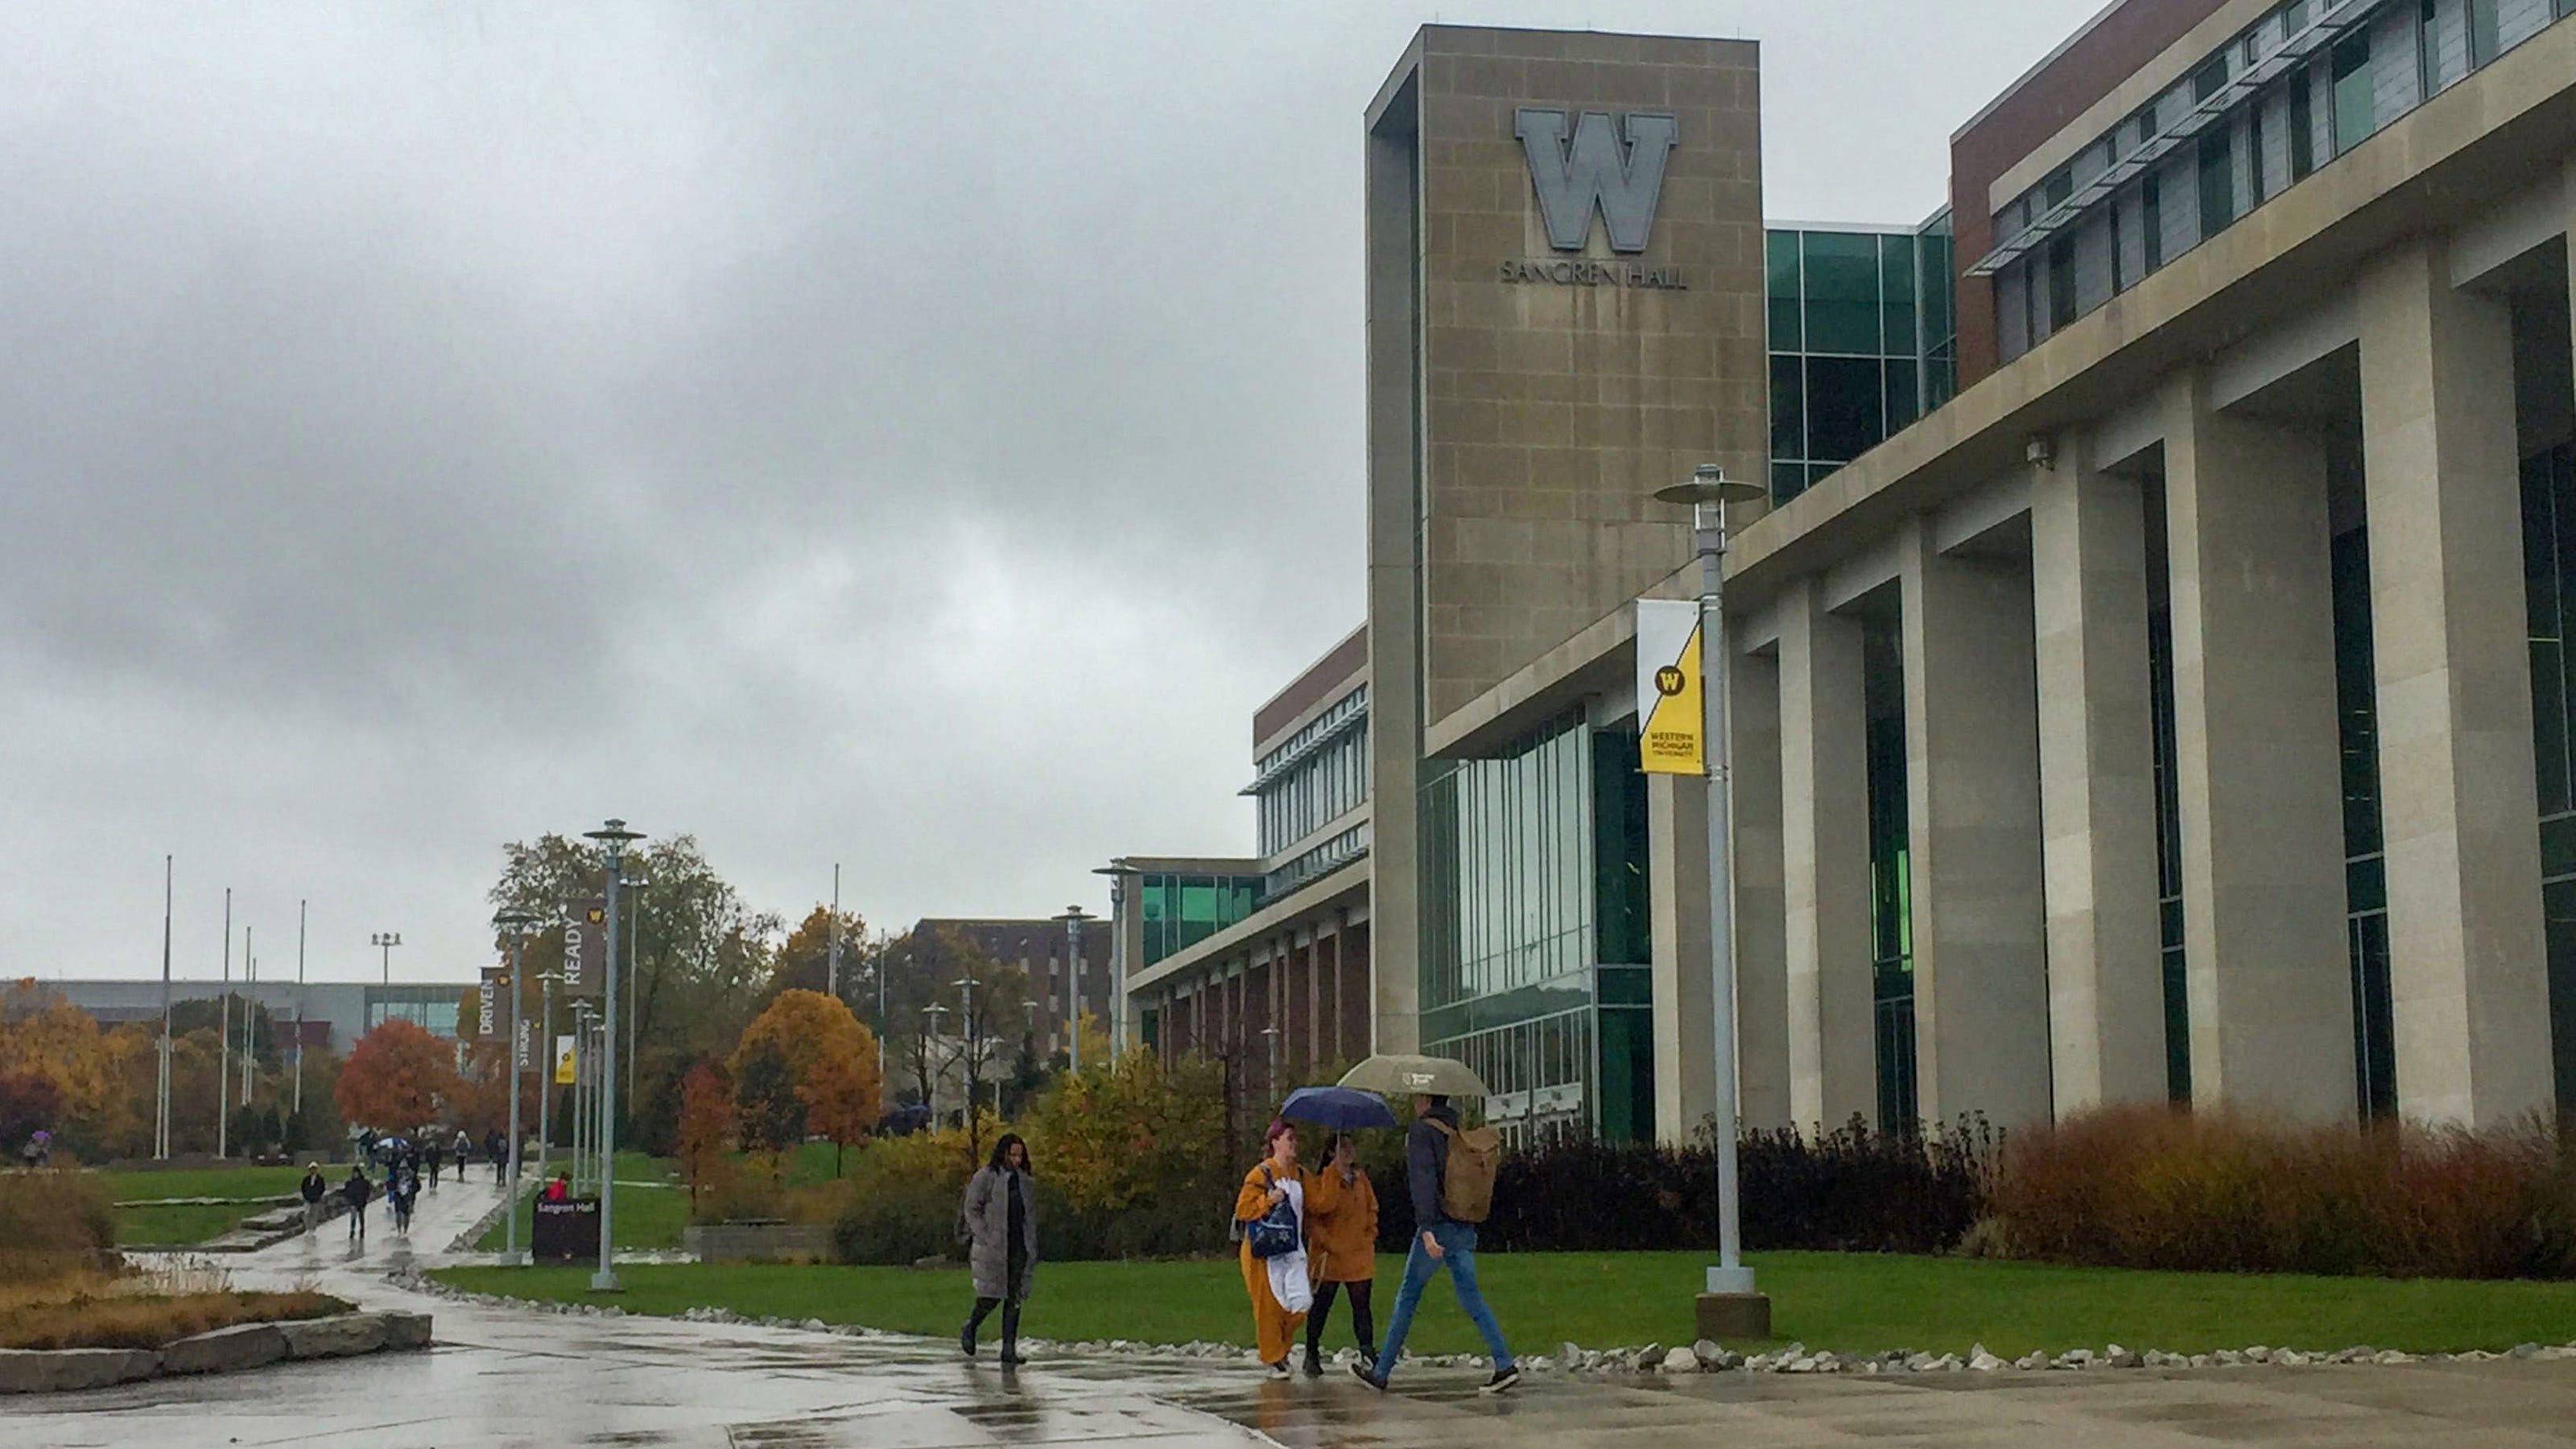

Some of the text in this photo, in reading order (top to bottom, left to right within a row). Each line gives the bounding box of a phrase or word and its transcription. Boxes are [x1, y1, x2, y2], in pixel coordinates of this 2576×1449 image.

[1514, 106, 1678, 251] W
[1501, 261, 1687, 290] SANGREN HALL
[1660, 671, 1679, 691] W
[1651, 733, 1694, 741] WESTERN
[565, 916, 582, 985] READY
[479, 978, 494, 1034] DRIVEN
